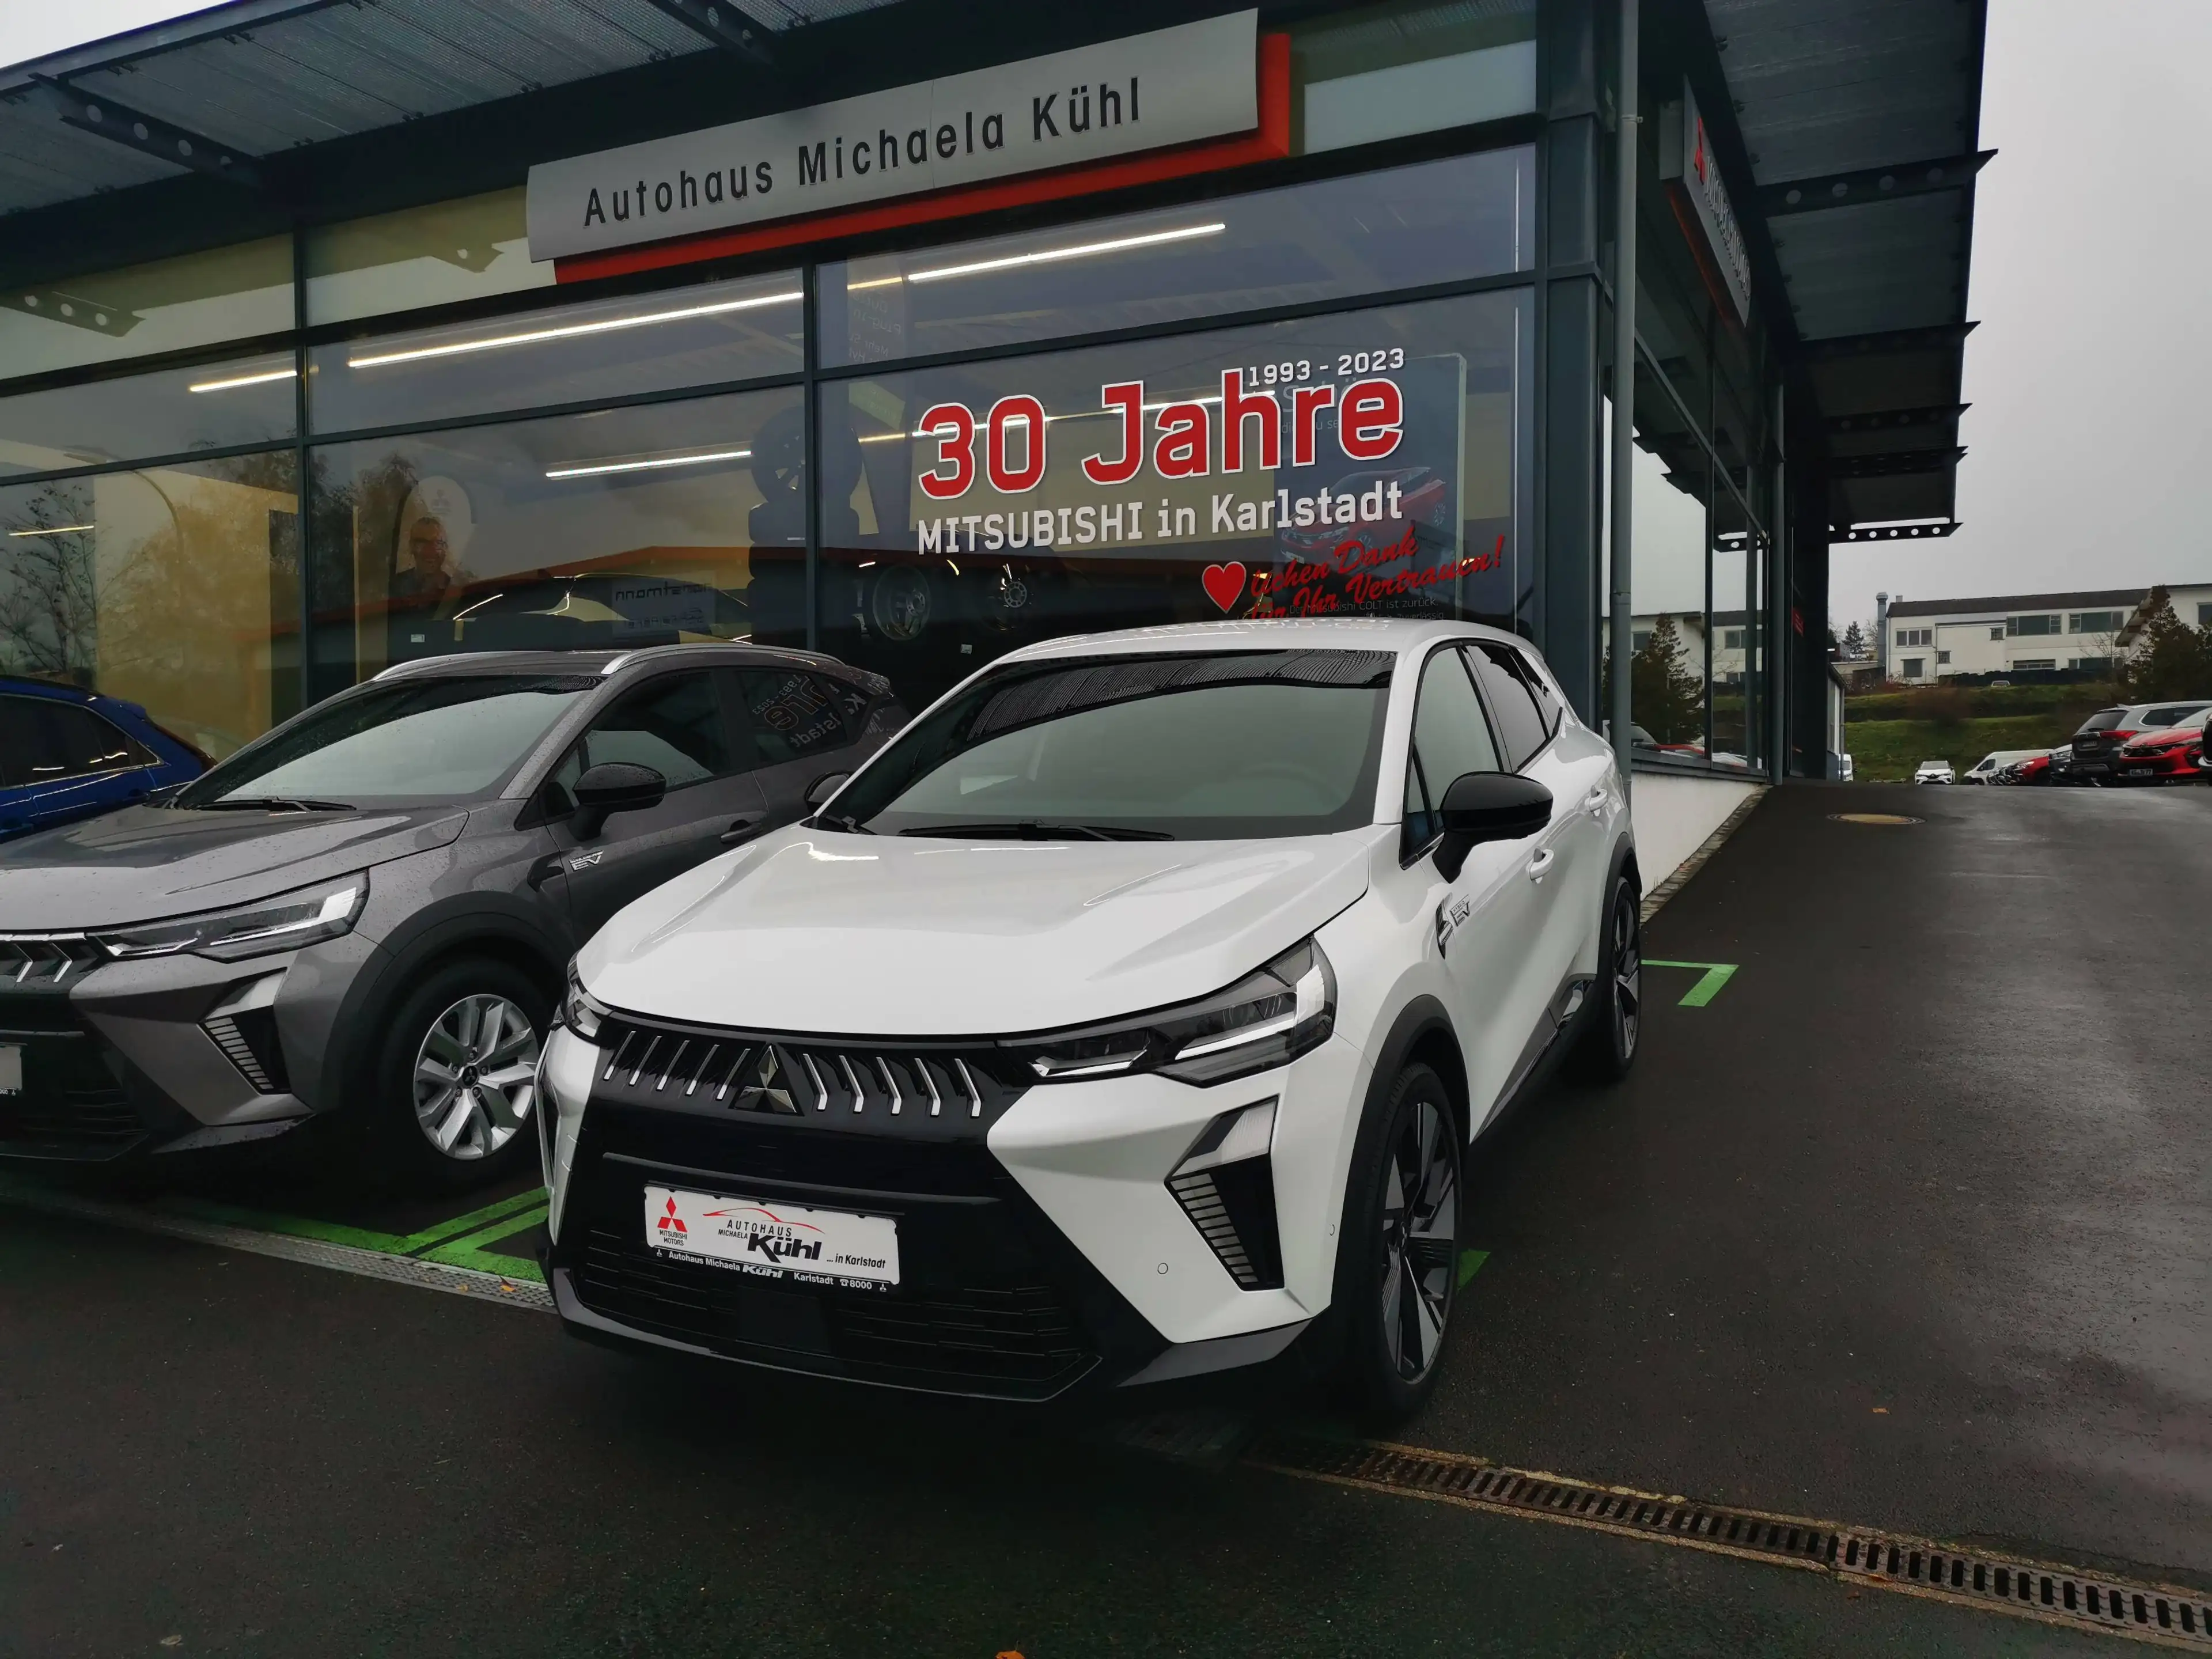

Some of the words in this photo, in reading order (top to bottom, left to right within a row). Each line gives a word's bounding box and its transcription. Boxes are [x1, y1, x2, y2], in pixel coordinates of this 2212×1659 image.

[583, 161, 773, 228] Autohaus
[798, 111, 1004, 186] Michaela
[1032, 76, 1140, 142] Kühl
[1249, 359, 1310, 387] 1993
[1338, 347, 1404, 376] 2023
[918, 394, 1046, 499] 30
[1081, 368, 1403, 486] Jahre
[918, 501, 1143, 555] MITSUBISHI
[1157, 498, 1195, 538] in
[1211, 480, 1403, 534] Karlstadt
[1334, 520, 1419, 574] Dank
[1345, 533, 1505, 604] Vertrauen!
[1359, 600, 1383, 611] COLT
[1386, 599, 1400, 609] ist
[659, 1229, 688, 1240] MITSUBISHI
[664, 1238, 684, 1247] MOTORS
[727, 1219, 792, 1237] AUTOHAUS
[668, 1251, 704, 1265] Autohaus
[706, 1258, 740, 1271] Michaela
[743, 1264, 783, 1278] Kühl
[794, 1272, 834, 1285] Karlstadt
[718, 1229, 748, 1240] MICHAELA
[747, 1233, 822, 1264] Kühl
[845, 1255, 886, 1268] Karlstadt
